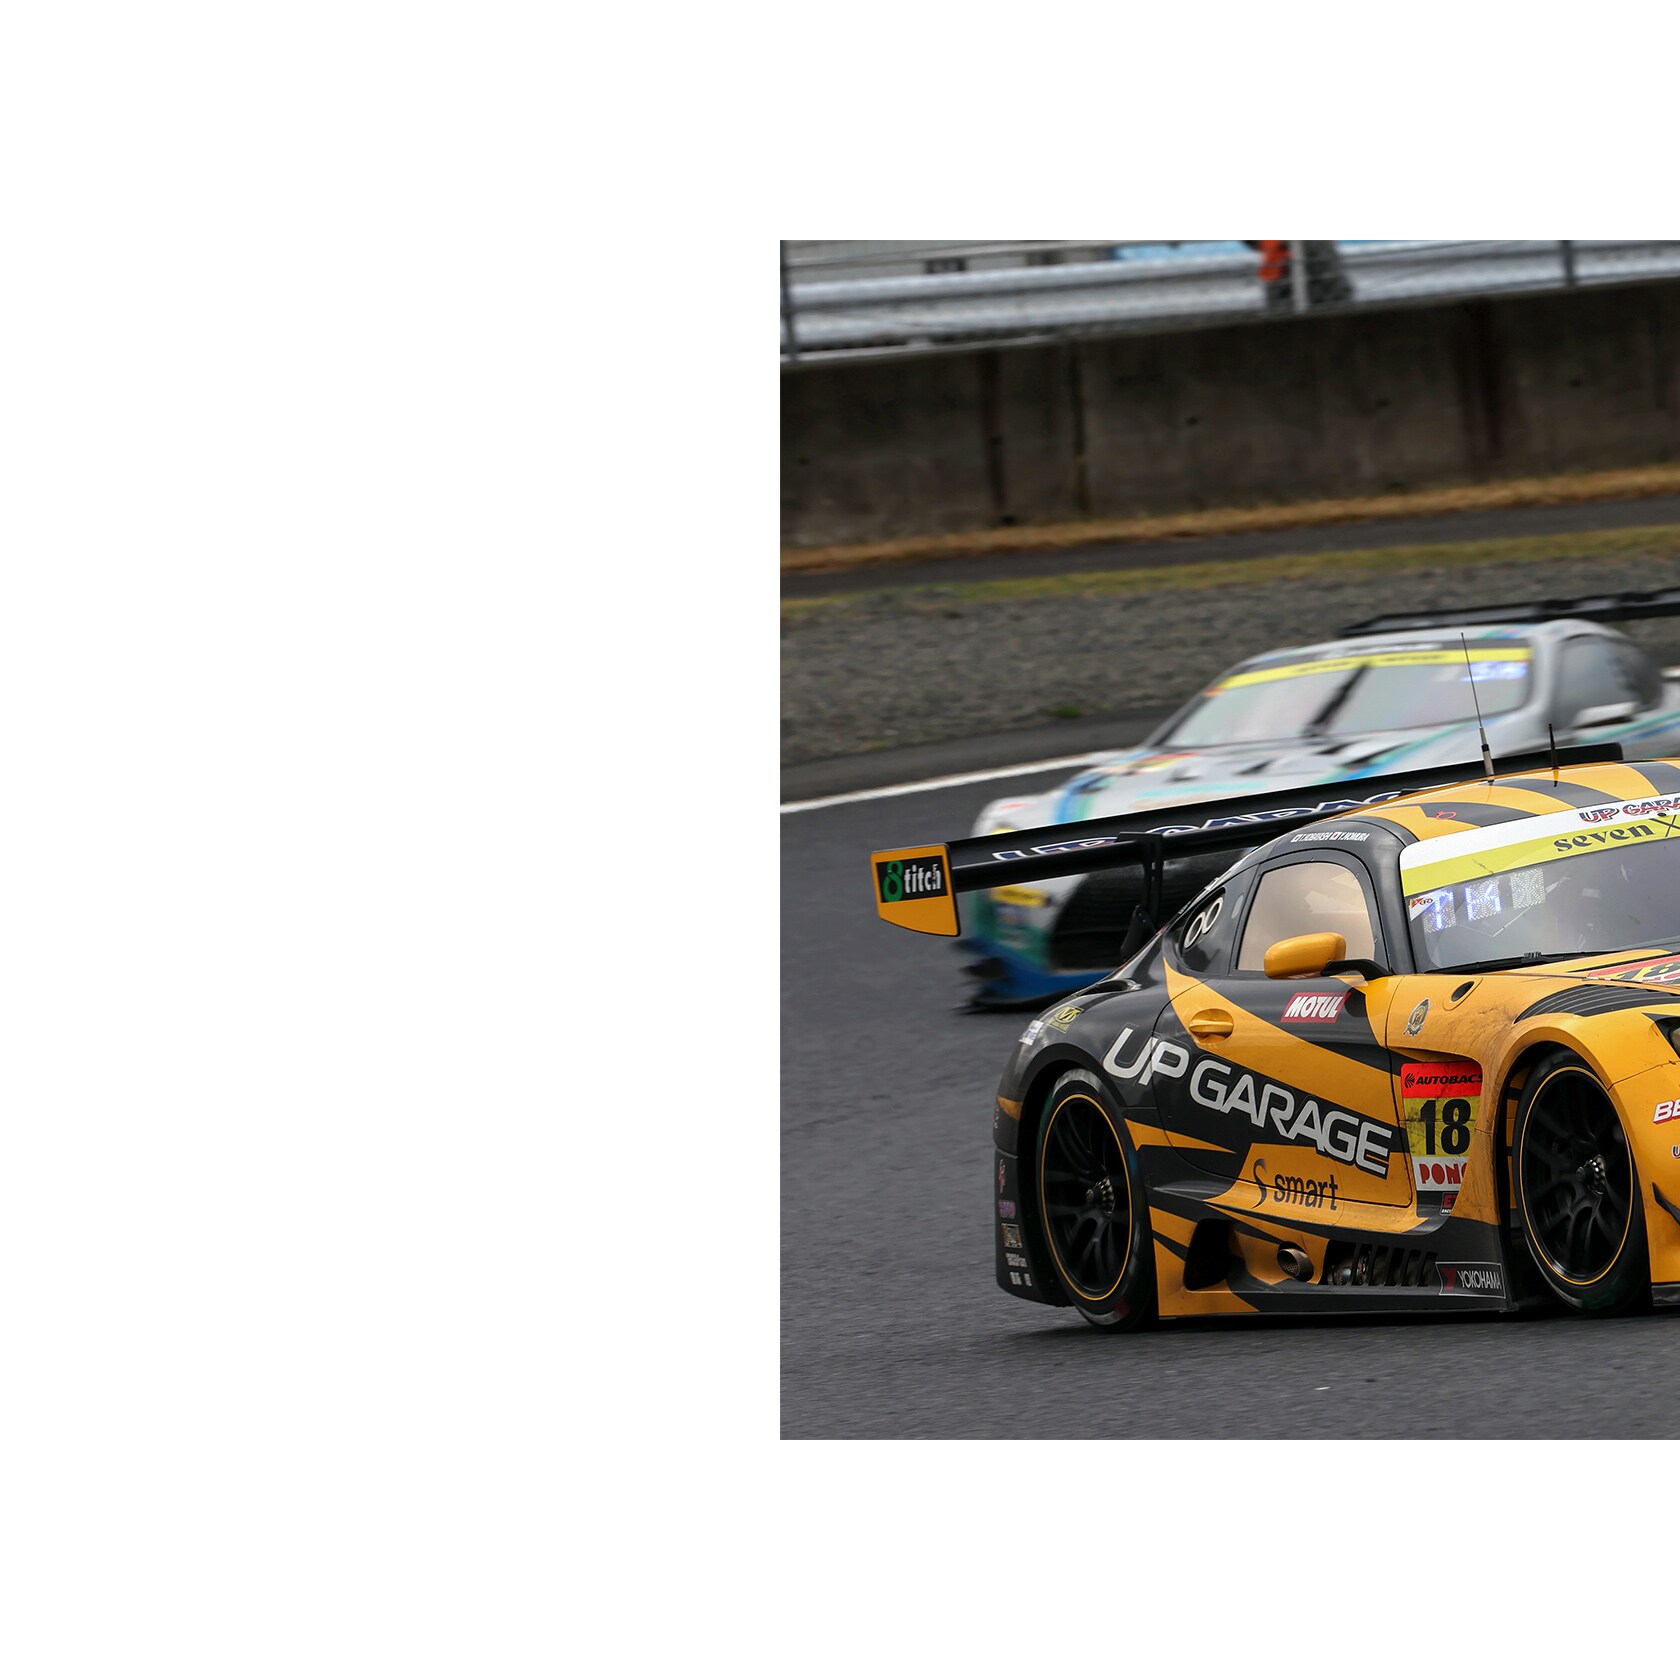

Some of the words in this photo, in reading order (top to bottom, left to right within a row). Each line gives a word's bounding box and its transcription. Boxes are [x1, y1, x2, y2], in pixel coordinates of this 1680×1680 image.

[1578, 807, 1620, 824] UP
[1553, 824, 1654, 852] seven
[1284, 995, 1344, 1018] MOTUL
[1102, 1027, 1190, 1085] UP
[1189, 1058, 1393, 1175] GARAGE
[1420, 1098, 1472, 1155] 18
[1273, 1174, 1339, 1211] smart
[1457, 1270, 1503, 1290] YOKOHAMA
